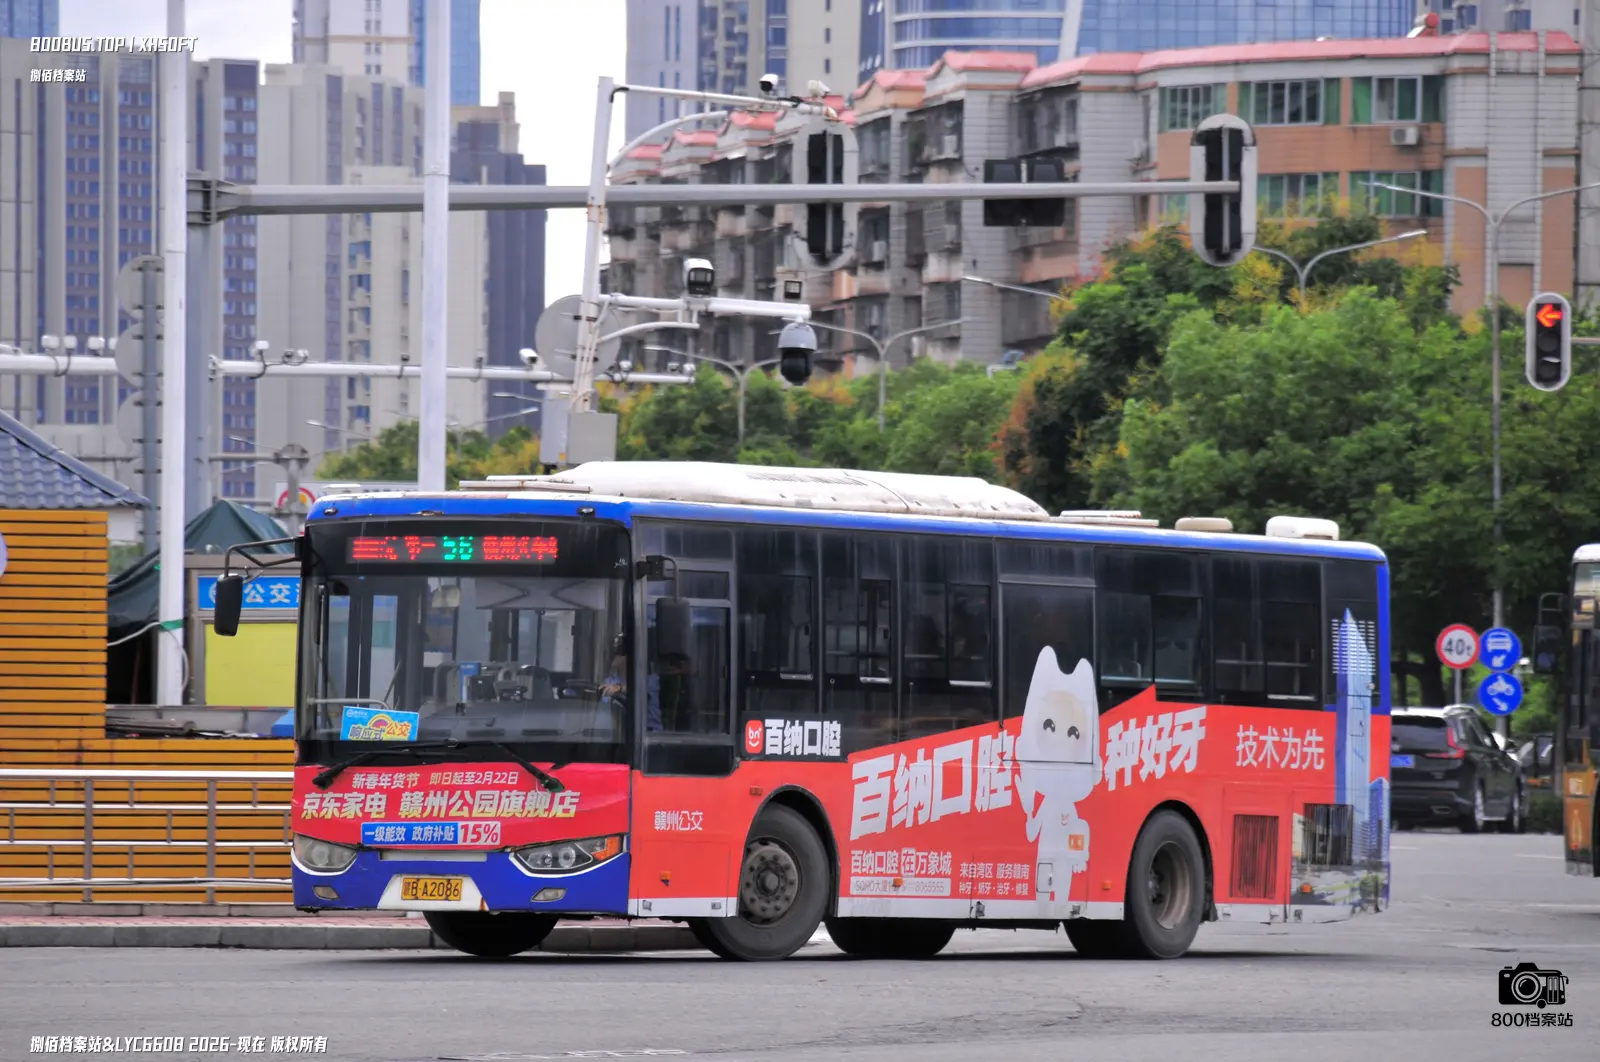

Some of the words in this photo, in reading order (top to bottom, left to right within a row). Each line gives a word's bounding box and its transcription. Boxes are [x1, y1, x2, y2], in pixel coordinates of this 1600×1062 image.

[243, 583, 300, 604] 公交
[765, 719, 841, 757] 百纳口腔
[1235, 724, 1325, 770] 技术为先
[352, 772, 420, 789] 新春年货节
[429, 771, 519, 786] 即日起至2月22日
[850, 730, 1016, 841] 百纳口腔
[1104, 705, 1207, 792] 种好牙
[301, 791, 387, 820] 京东家电
[397, 789, 580, 819] 赣州公园旗舰店
[654, 810, 703, 831] 赣州公交
[364, 826, 406, 843] 一级能效
[412, 825, 455, 842] 政府补贴
[460, 823, 499, 844] 15%
[851, 848, 952, 876] 百纳口腔在万象城
[959, 862, 993, 880] 来自湾区
